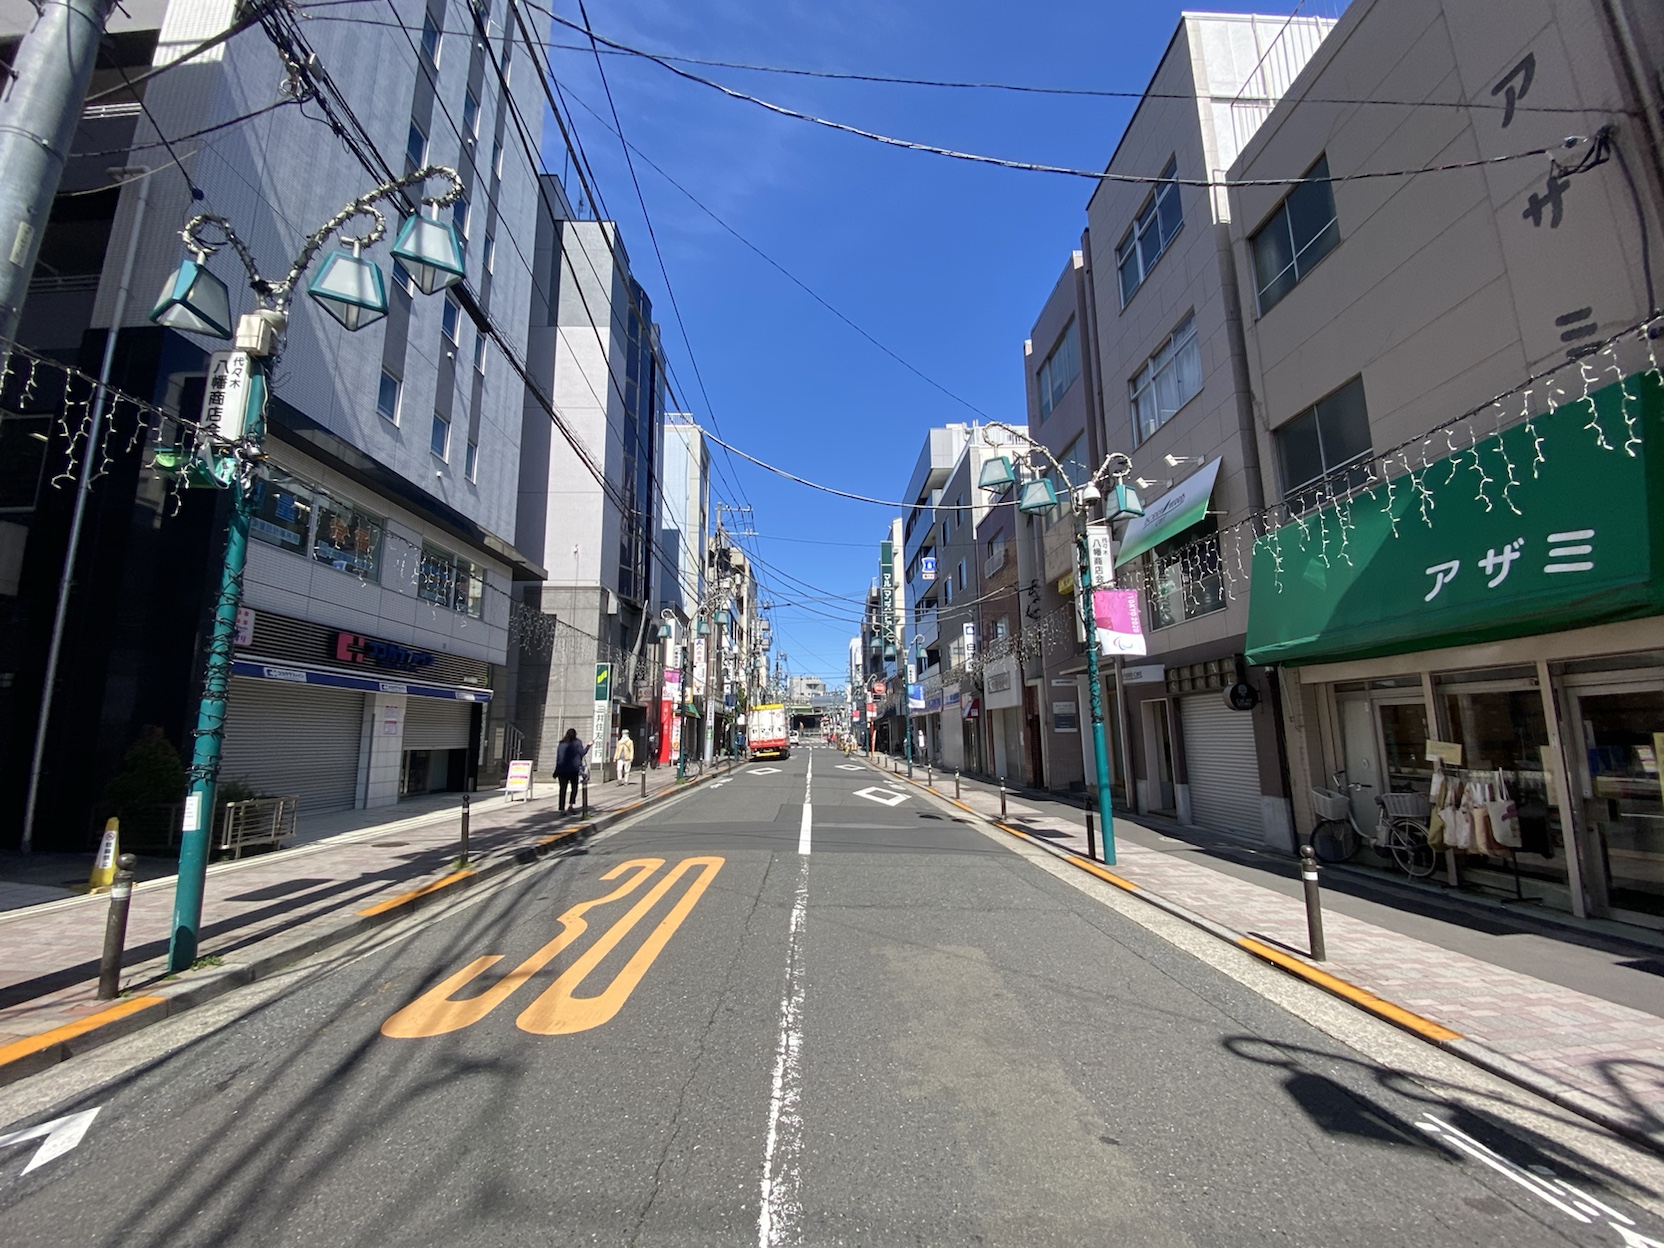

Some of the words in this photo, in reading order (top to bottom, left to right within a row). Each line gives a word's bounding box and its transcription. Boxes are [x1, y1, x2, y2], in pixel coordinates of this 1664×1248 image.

[229, 357, 245, 388] 代々木
[1092, 539, 1104, 584] 八幡商店会
[1425, 528, 1595, 602] アザミ
[1131, 618, 1140, 633] 2020
[595, 705, 606, 758] 三井住友銀行
[381, 856, 726, 1038] 30
